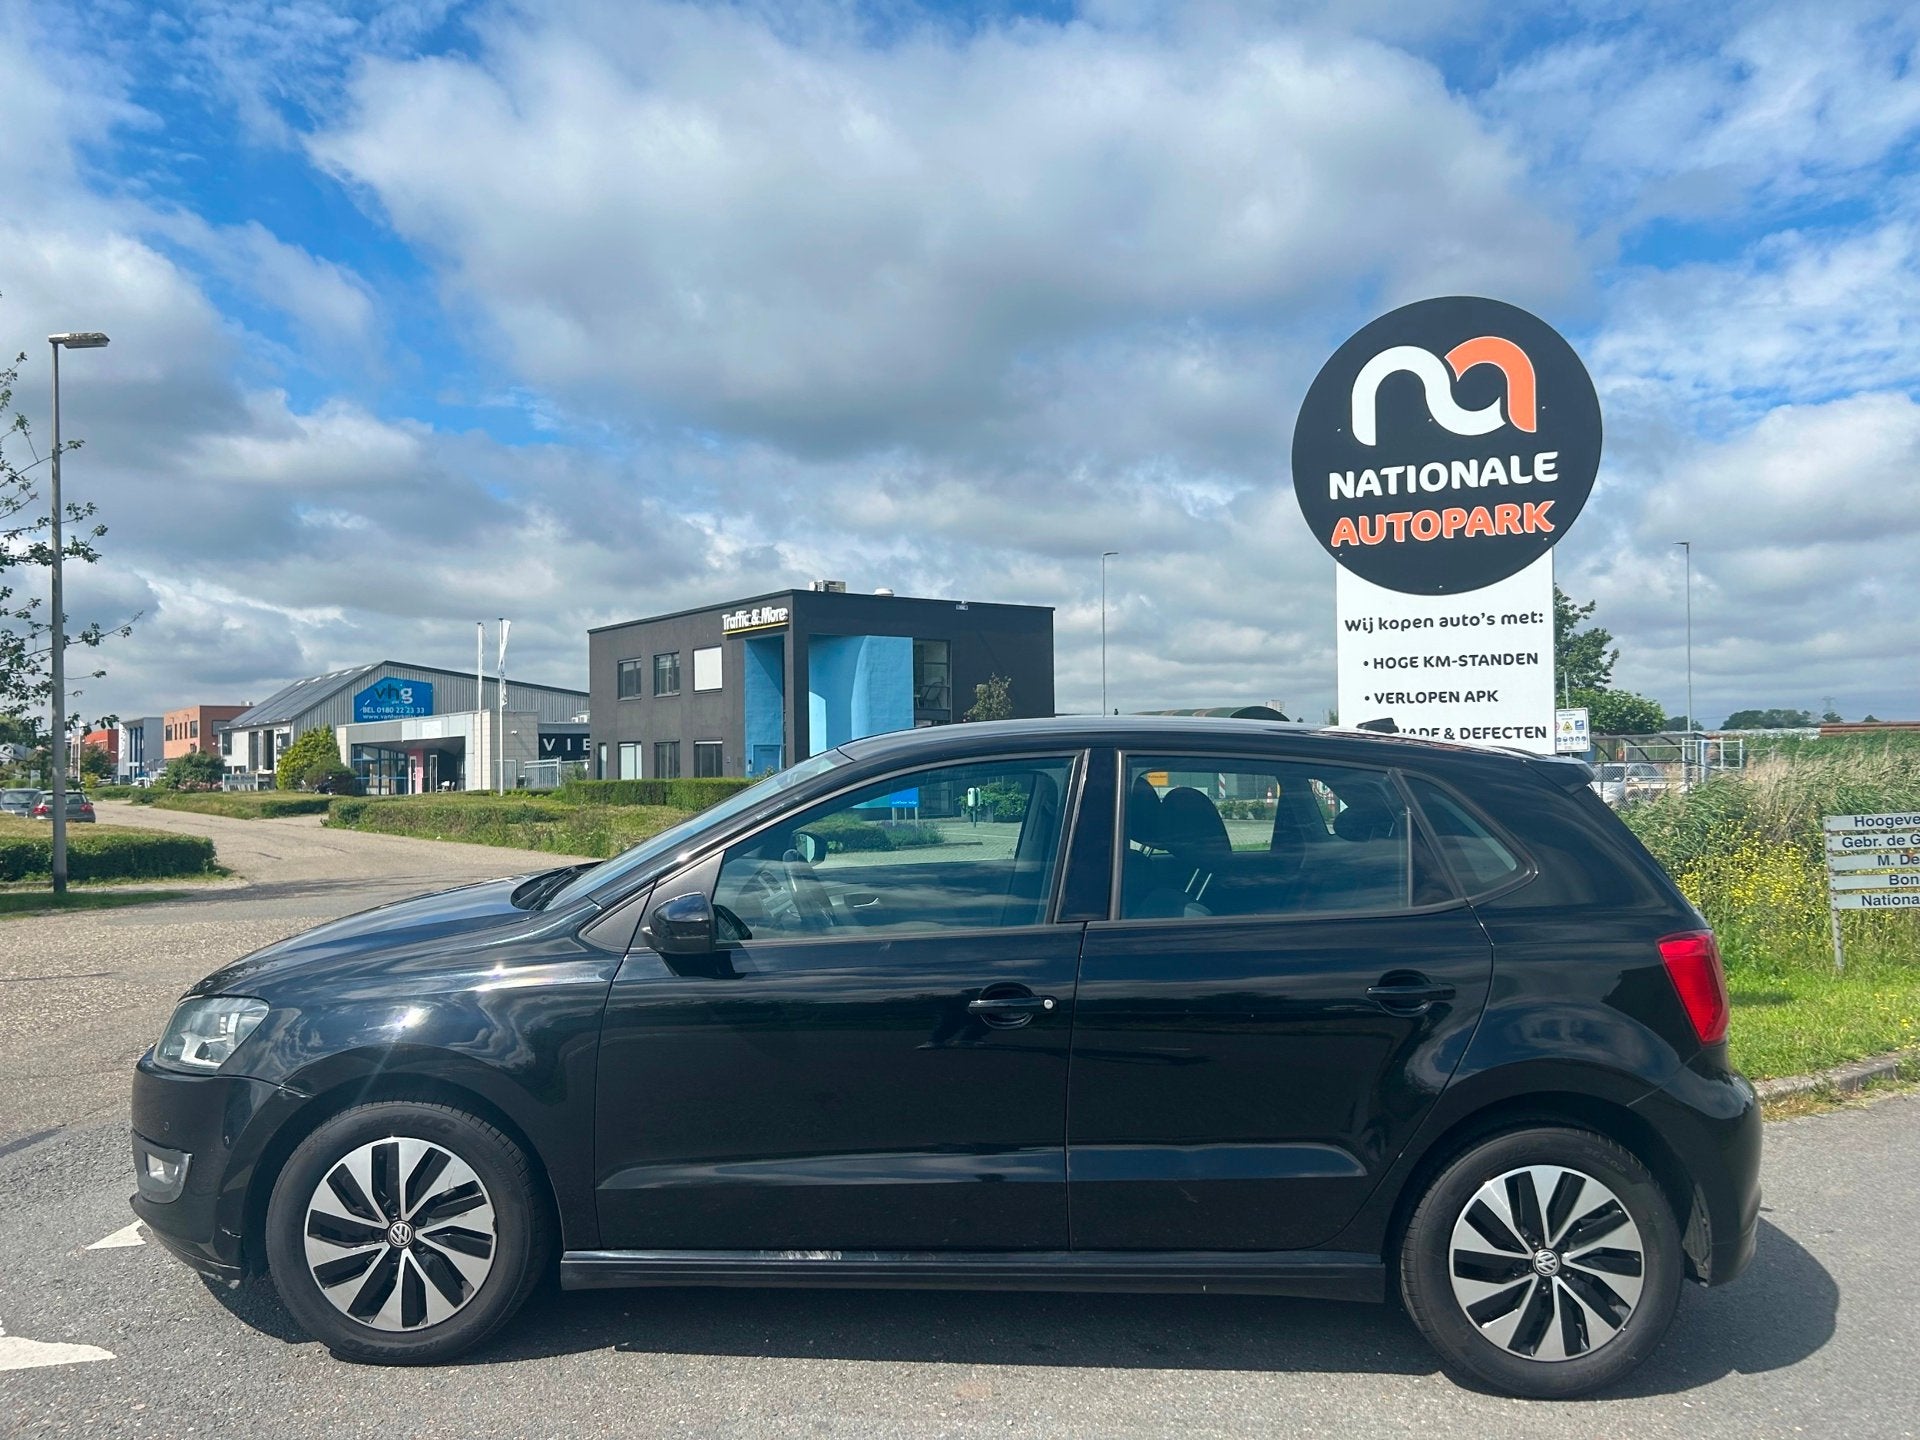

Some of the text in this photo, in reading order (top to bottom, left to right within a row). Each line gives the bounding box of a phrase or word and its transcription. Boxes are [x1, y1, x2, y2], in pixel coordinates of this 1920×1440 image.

[1329, 451, 1559, 500] NATIONALE
[1330, 500, 1556, 548] AUTOPARK
[722, 606, 788, 630] Traffic & More
[1345, 611, 1544, 634] Wij kopen auto's met:
[1373, 653, 1538, 670] HOGE KM-STANDEN
[374, 683, 413, 704] vhg
[1374, 690, 1499, 705] VERLOPEN APK
[1443, 727, 1456, 741] &
[1459, 726, 1547, 740] DEFECTEN
[1842, 836, 1882, 848] Gebr.
[1887, 835, 1906, 846] de
[1877, 854, 1920, 866] M. De
[1889, 874, 1919, 885] Bon
[1861, 895, 1920, 907] Nationa
